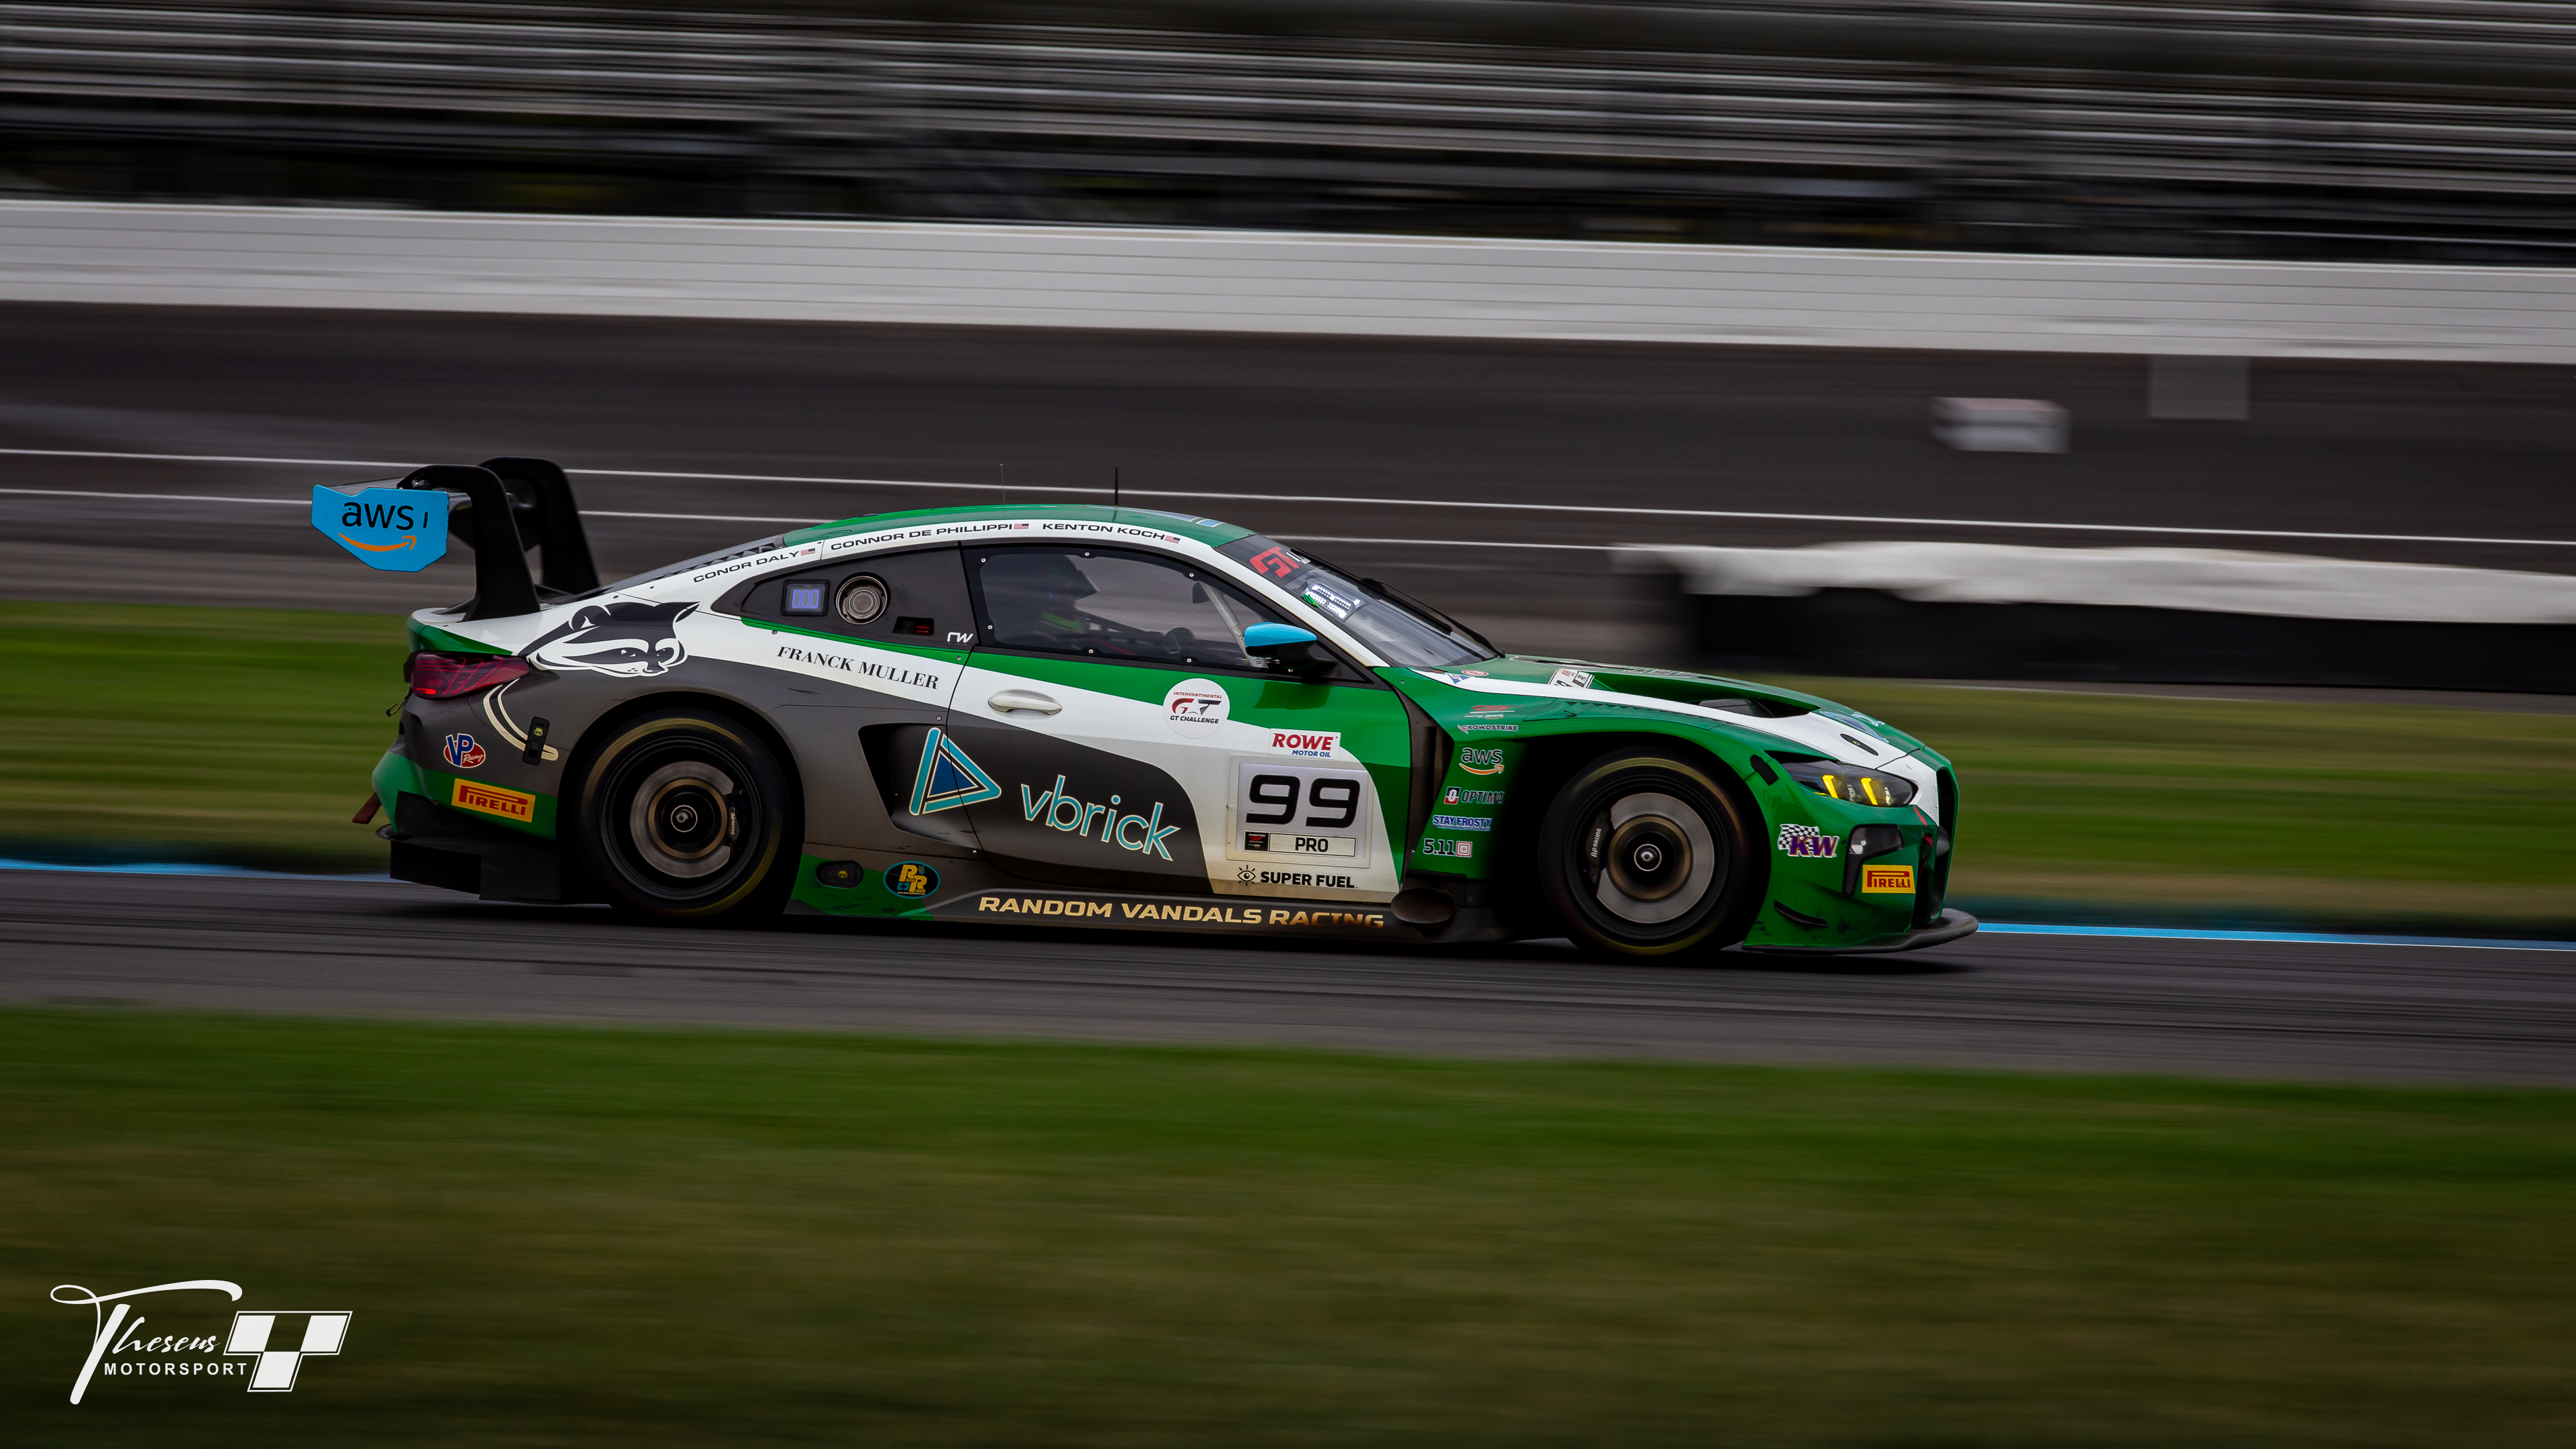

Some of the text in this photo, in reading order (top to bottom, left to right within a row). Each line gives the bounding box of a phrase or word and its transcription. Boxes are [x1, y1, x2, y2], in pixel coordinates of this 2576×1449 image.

[341, 501, 414, 531] aws
[830, 523, 1013, 551] CONNOR DE PHILLIPPI
[1042, 523, 1165, 540] KENTON KOCH
[693, 551, 800, 583] CONOR DALY
[776, 645, 940, 690] FRANCK MULLER
[1173, 691, 1223, 699] INTERCONTINENTAL
[1180, 716, 1220, 724] CHALLENGE
[1461, 724, 1519, 732] CROWDSTRIKE
[445, 733, 475, 767] VP
[1272, 733, 1334, 751] ROWE
[1460, 747, 1503, 765] aws
[458, 784, 529, 816] PIRELLI
[1245, 773, 1361, 829] 99
[1461, 790, 1505, 804] OPTIMA
[1020, 774, 1181, 862] vbrick
[1432, 814, 1493, 828] STAY FROSTY
[1295, 837, 1329, 853] PRO
[1423, 838, 1455, 856] 5.11
[1787, 836, 1839, 858] KW
[1260, 871, 1355, 888] SUPER FUEL
[1866, 870, 1911, 888] PIRELLI
[979, 896, 1385, 929] RANDOM VANDALS RACING
